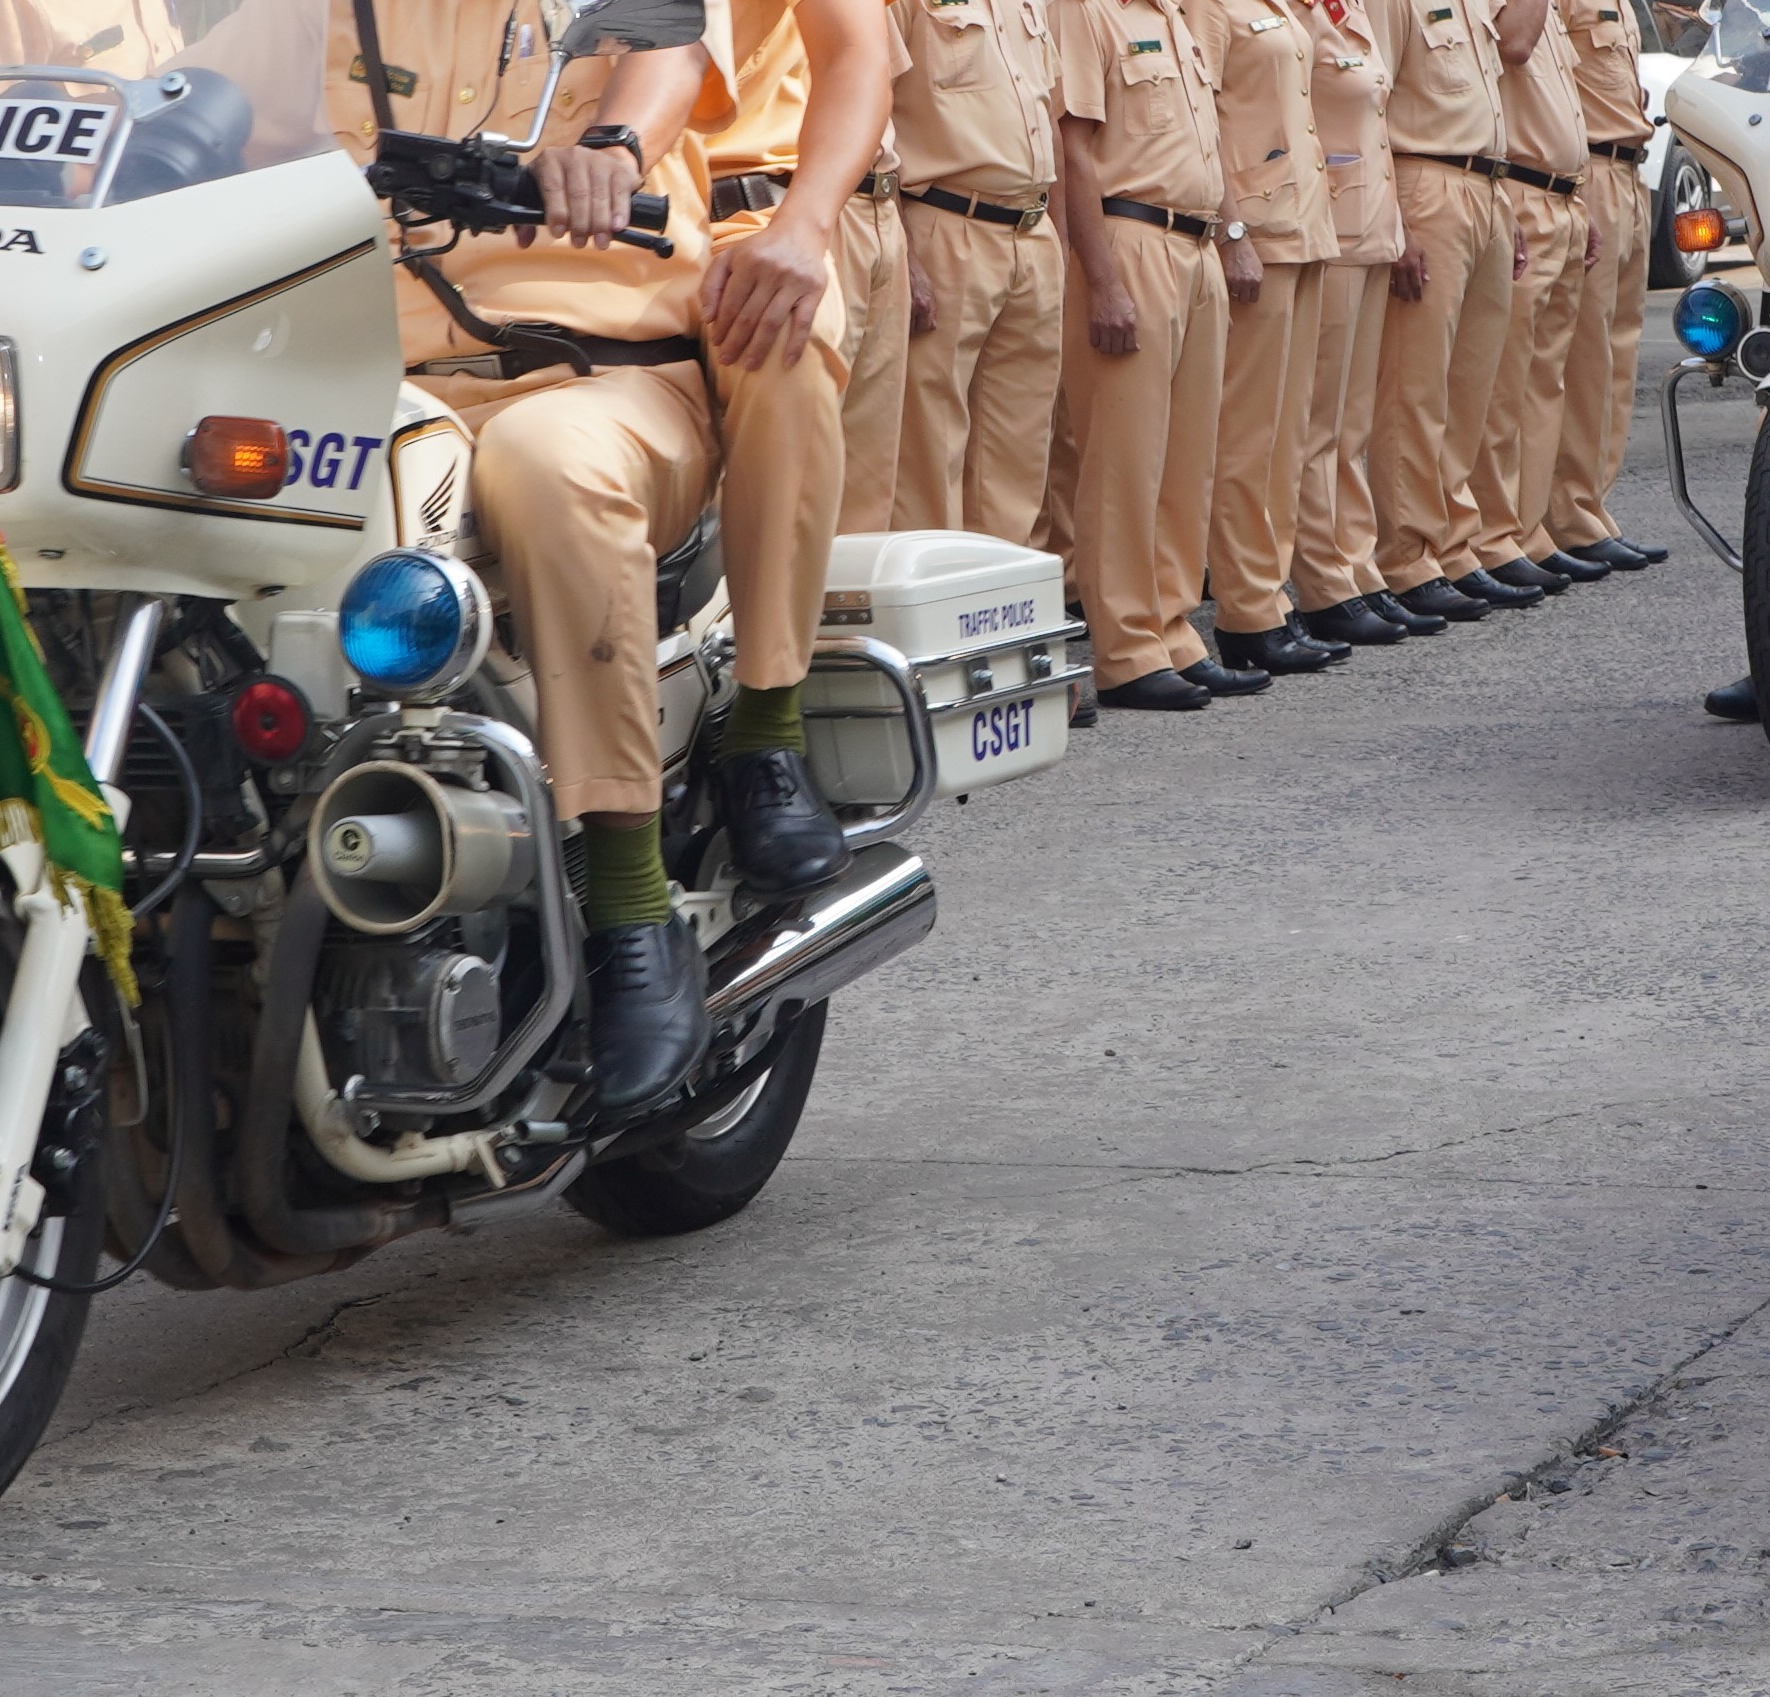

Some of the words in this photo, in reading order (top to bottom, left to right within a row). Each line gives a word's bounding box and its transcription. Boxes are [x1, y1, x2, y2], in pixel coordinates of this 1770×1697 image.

[282, 429, 384, 490] SGT
[959, 607, 998, 638] TRAFFIC
[1002, 599, 1035, 629] POLICE
[973, 698, 1035, 761] CSGT
